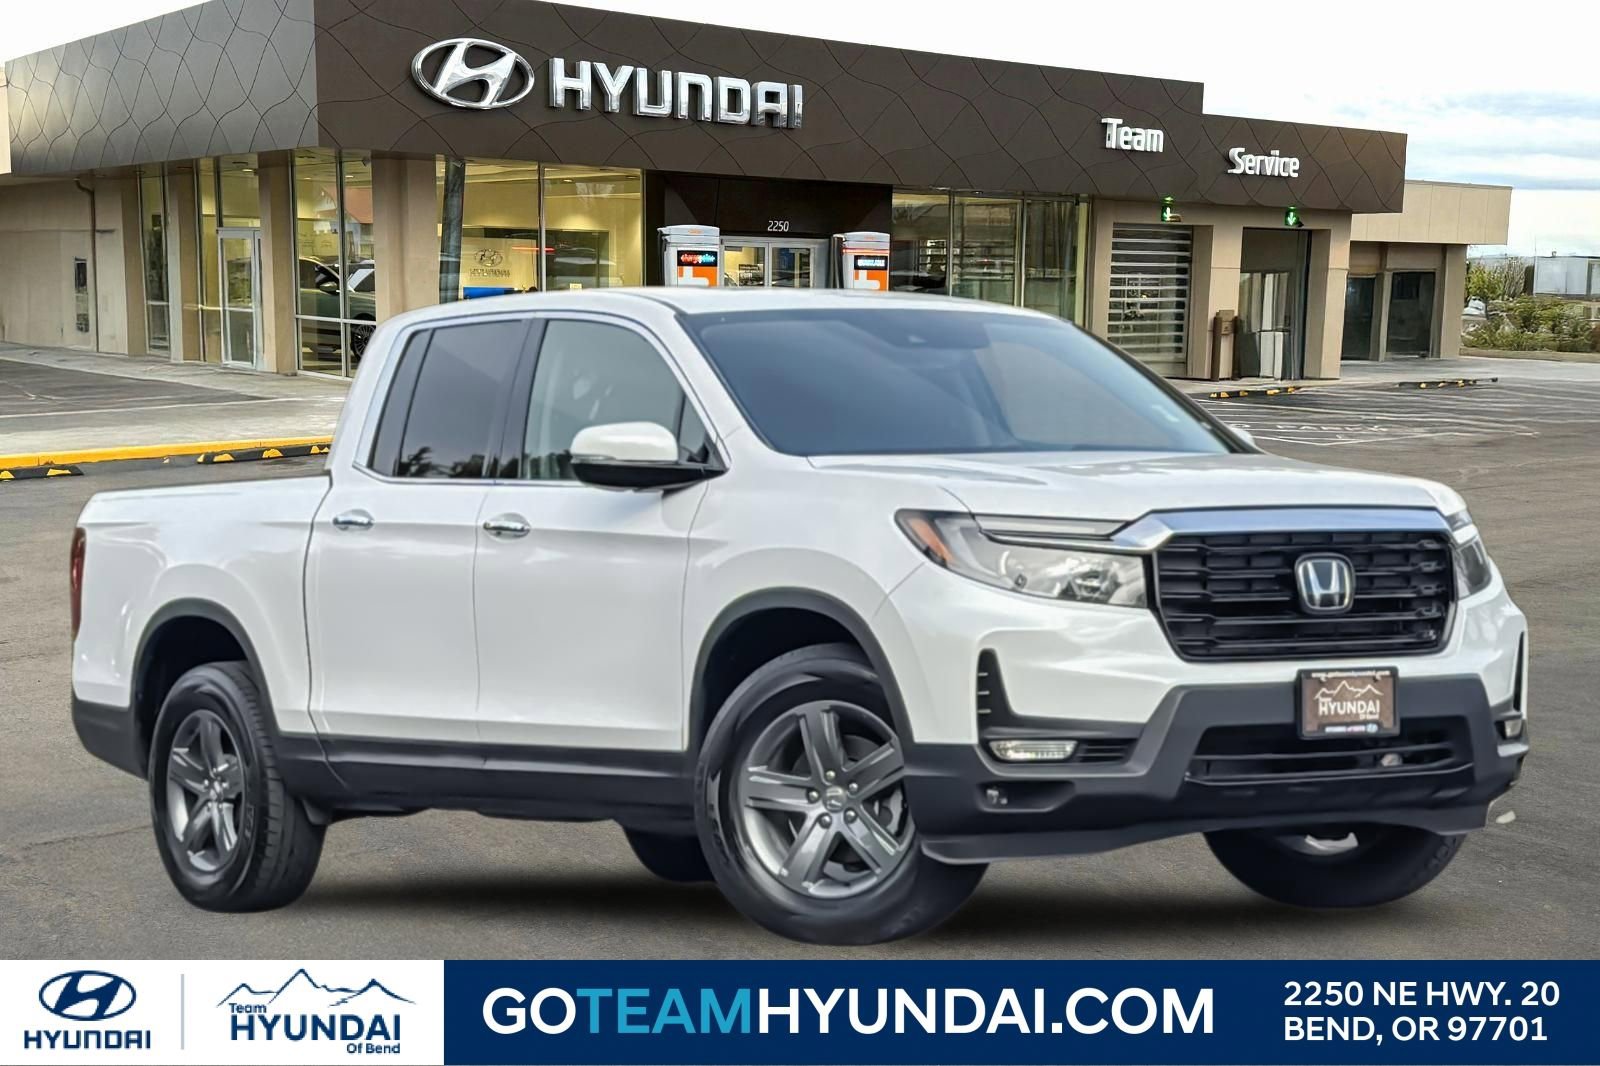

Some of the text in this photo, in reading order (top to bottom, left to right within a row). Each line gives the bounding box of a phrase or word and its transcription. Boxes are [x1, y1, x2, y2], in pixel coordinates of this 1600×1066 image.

[549, 57, 803, 129] HYUNDAI
[1101, 117, 1164, 153] Team
[1227, 147, 1300, 178] Service
[767, 220, 790, 232] 2250
[1318, 699, 1381, 716] HYUNDAI
